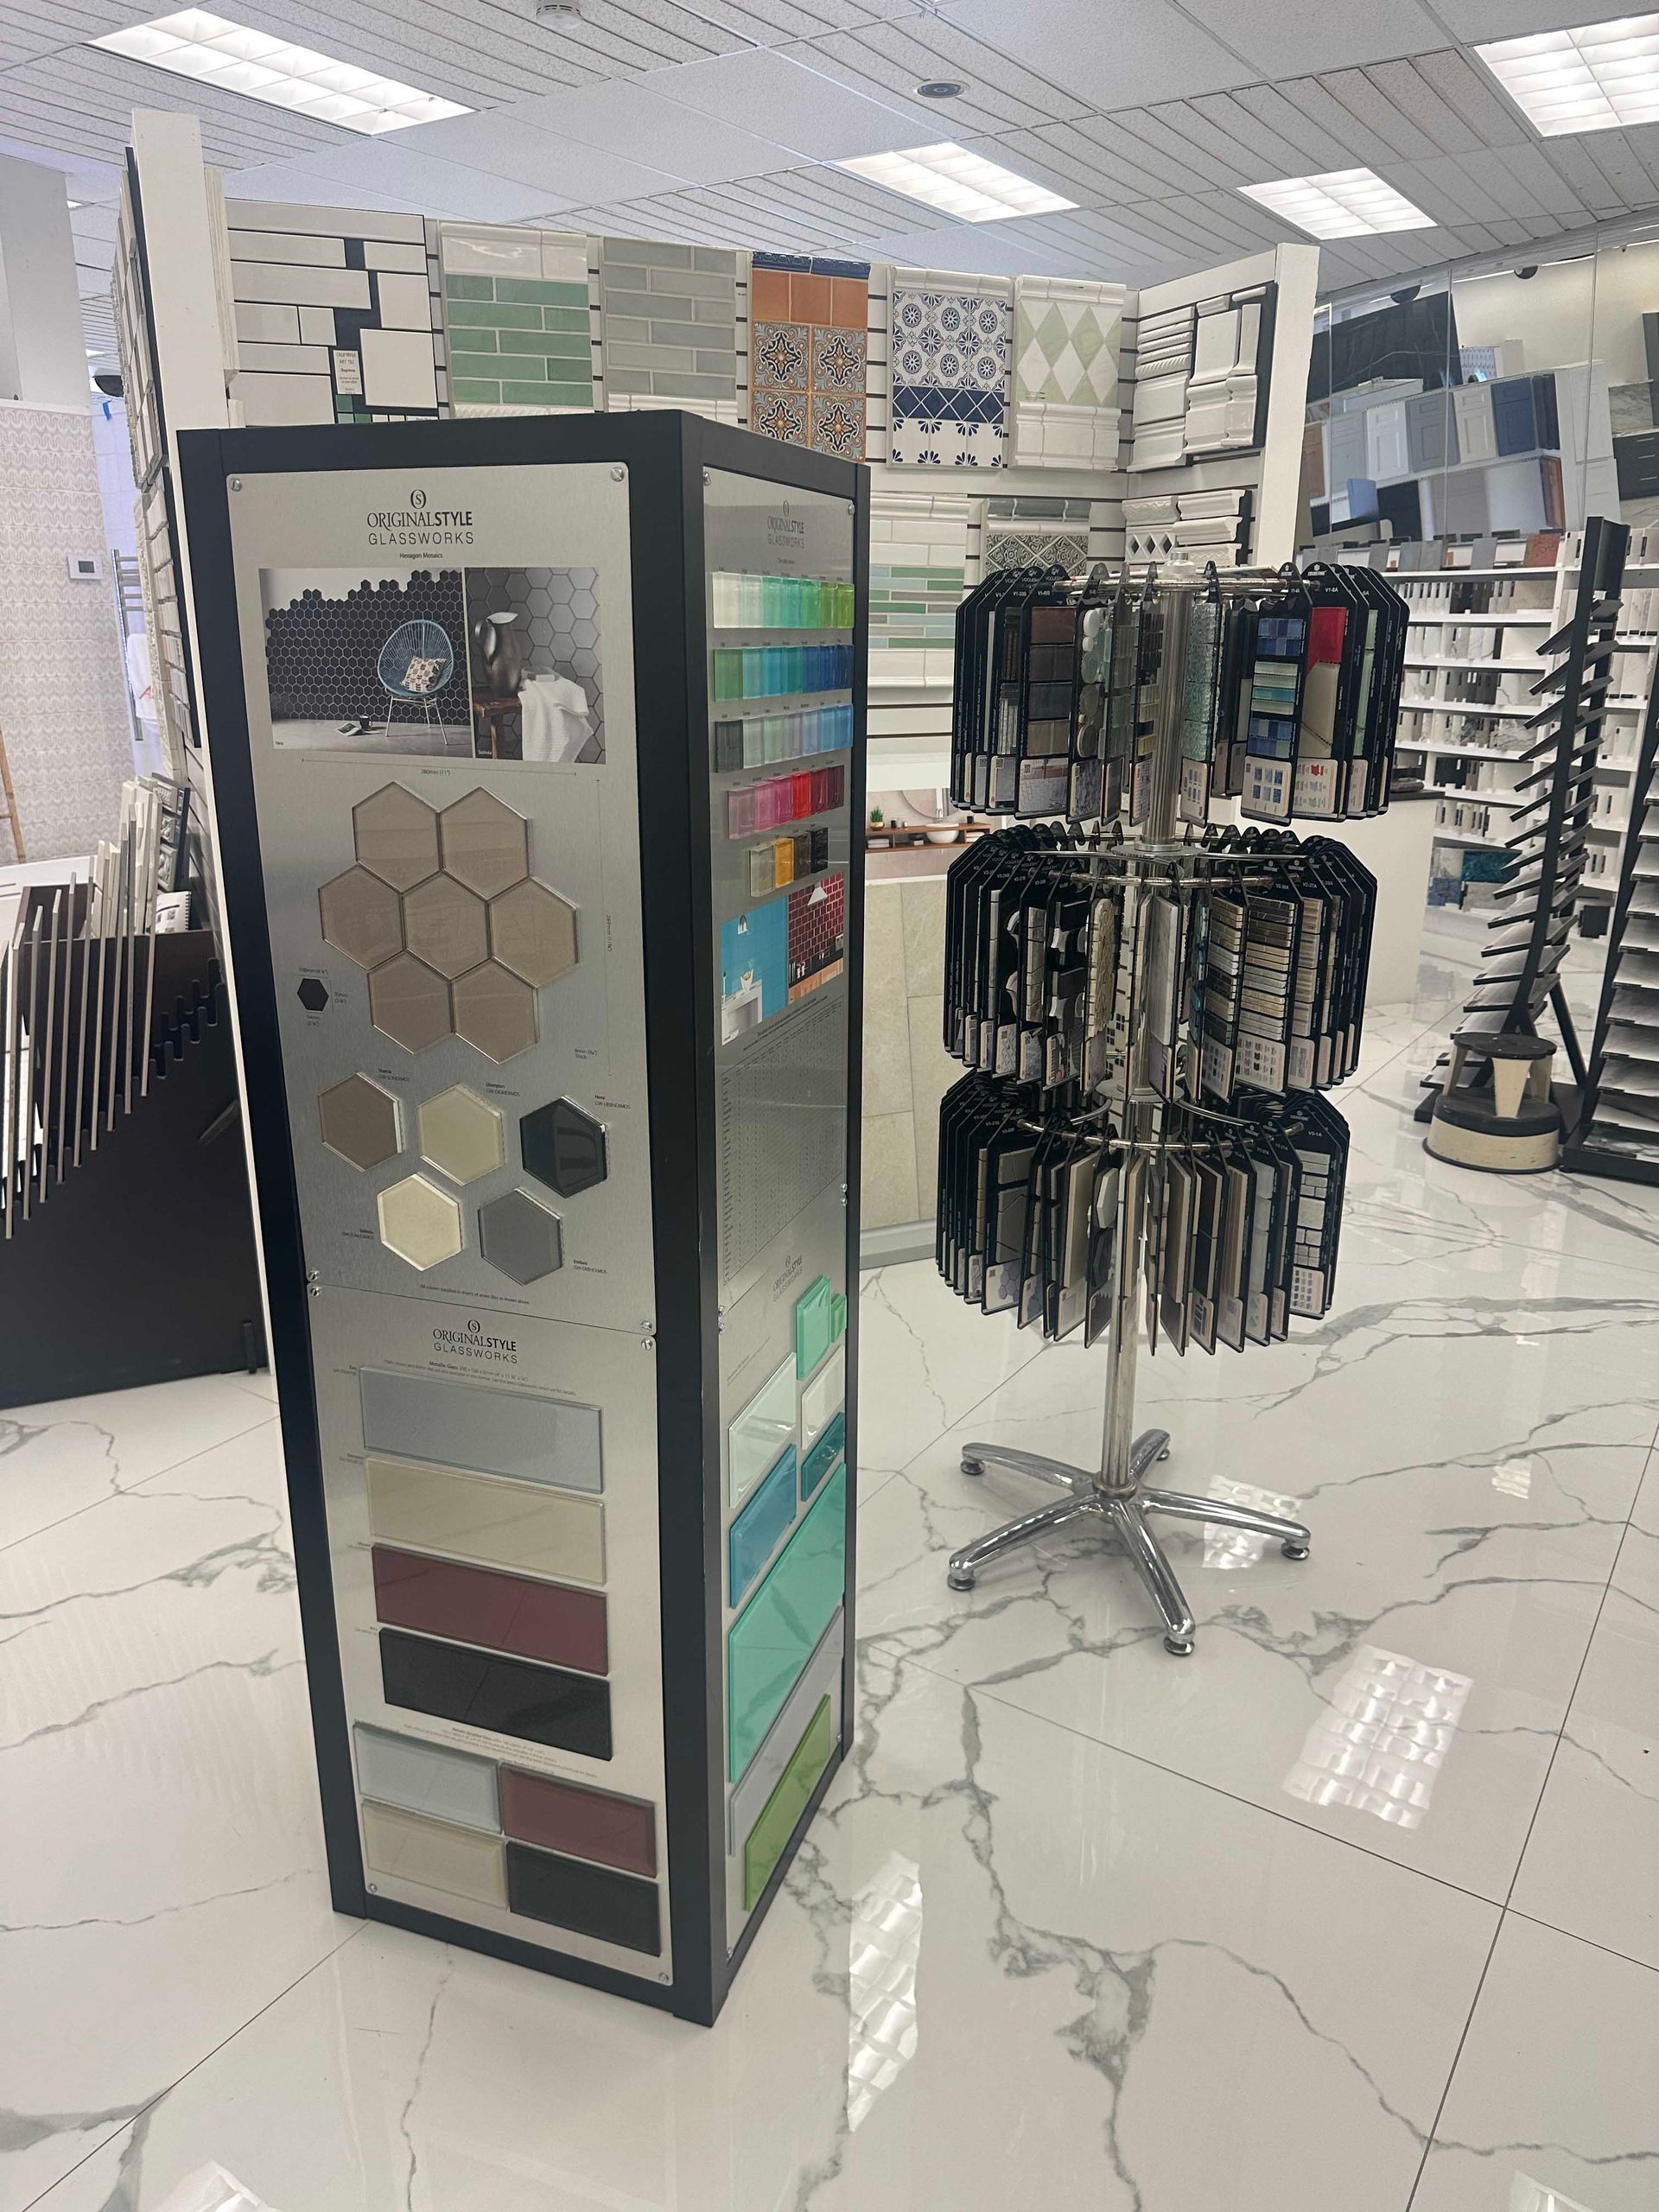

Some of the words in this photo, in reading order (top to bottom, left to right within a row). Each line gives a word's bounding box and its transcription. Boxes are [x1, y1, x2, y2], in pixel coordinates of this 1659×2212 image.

[366, 512, 473, 531] ORIGINALSTYLE
[368, 531, 474, 545] GLASSWORKS
[433, 1328, 517, 1351] ORIGINALSTYLE
[434, 1342, 518, 1364] GLASSWORKS
